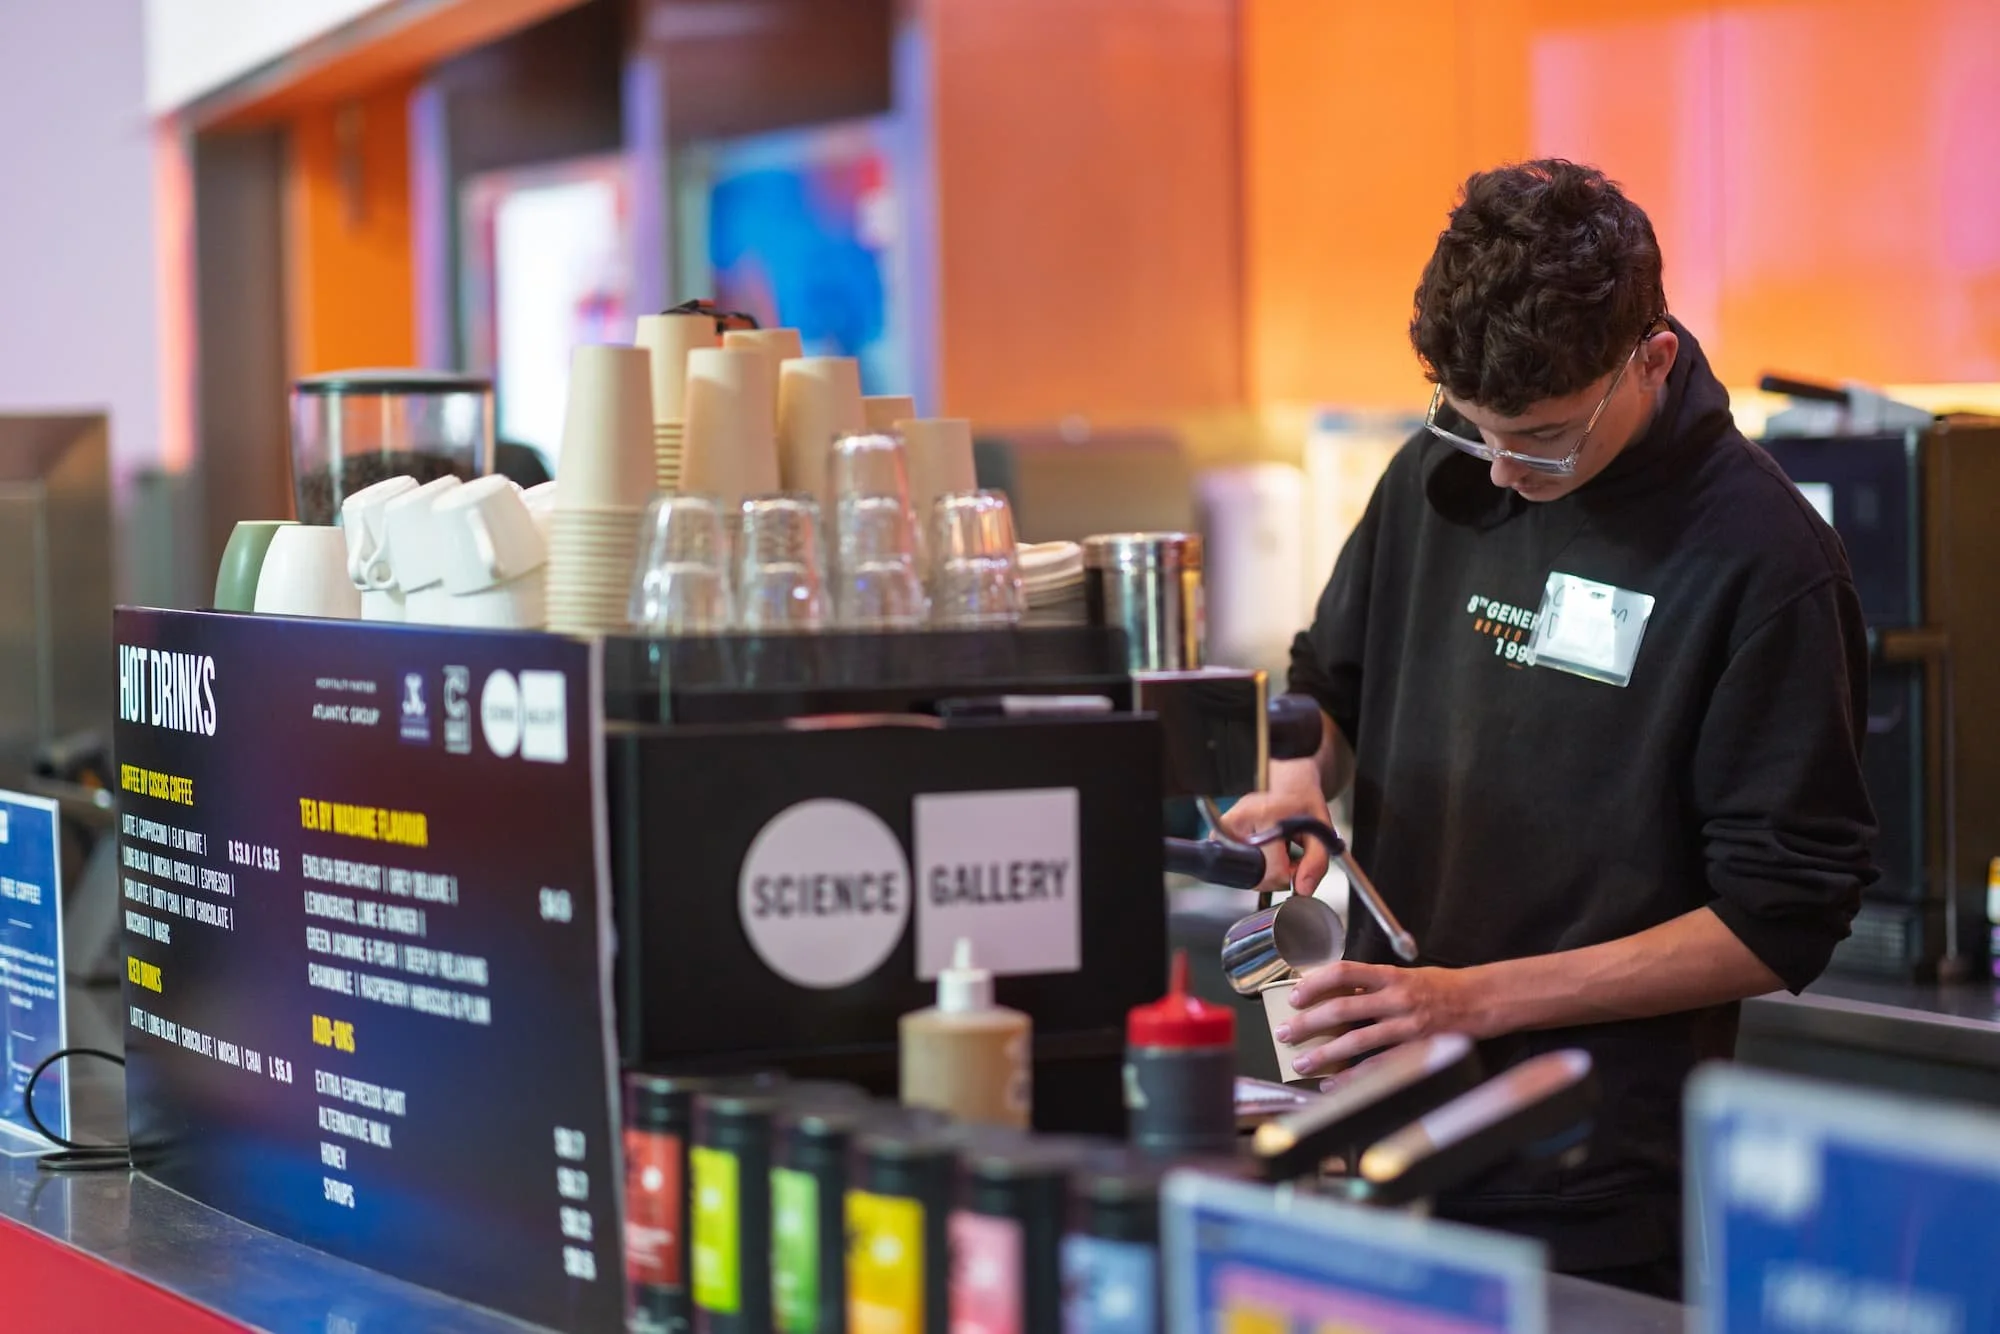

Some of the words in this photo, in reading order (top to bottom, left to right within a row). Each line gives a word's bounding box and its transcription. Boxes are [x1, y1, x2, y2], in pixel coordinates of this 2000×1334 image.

[119, 644, 147, 724] HOT
[150, 649, 217, 736] DRINKS
[312, 703, 348, 723] ATLANTIC
[349, 704, 381, 726] GROUP
[121, 762, 140, 794] COFFEE
[140, 768, 148, 796] BY
[169, 775, 193, 806] COFFEE
[122, 813, 136, 837] LATTE
[139, 818, 168, 845] CAPPUCCINO
[172, 827, 185, 849] FLAT
[185, 830, 203, 855] WHITE
[299, 797, 319, 830] TEA
[319, 800, 332, 832] BY
[333, 803, 378, 841] MADAME
[377, 807, 429, 848] FLAVOUR
[134, 849, 150, 873] BLACK
[152, 854, 171, 879] MOCHA
[173, 860, 196, 886] PICCOLO
[201, 867, 231, 895] ESPRESSO
[228, 839, 234, 862] R
[234, 840, 250, 867] $3.0
[257, 846, 263, 868] L
[263, 845, 280, 872] $3.5
[302, 853, 334, 882] ENGLISH
[334, 858, 382, 891] BREAKFAST
[388, 867, 412, 897] GREY
[412, 870, 451, 905] DELUXE
[752, 870, 899, 919] SCIENCE
[927, 857, 1068, 907] GALLERY
[124, 877, 136, 900] CHAI
[135, 881, 150, 905] LATTE
[152, 887, 167, 911] DIRTY
[167, 891, 181, 915] CHAI
[184, 897, 197, 920] HOT
[196, 900, 230, 929] CHOCOLATE
[356, 899, 377, 928] LIME
[386, 904, 419, 936] GINGER
[127, 955, 141, 985] ICED
[140, 960, 163, 993] DRINKS
[306, 926, 331, 955] GREEN
[331, 931, 365, 962] JASMINE
[373, 938, 397, 969] PEAR
[404, 944, 438, 977] DEEPLY
[438, 950, 489, 987] RELAXING
[360, 973, 410, 1009] RASPBERRY
[462, 992, 492, 1026] PLUM
[129, 1004, 145, 1030] LATTE
[147, 1012, 160, 1037] LONG
[160, 1018, 178, 1044] BLACK
[181, 1027, 213, 1057] CHOCOLATE
[217, 1039, 240, 1067] MOCHA
[245, 1048, 262, 1074] CHAI
[312, 1014, 355, 1053] ADD-ONS
[268, 1055, 275, 1079] L
[275, 1056, 293, 1084] $5.0
[315, 1068, 342, 1098] EXTRA
[341, 1075, 383, 1111] ESPRESSO
[382, 1086, 406, 1117] SHOT
[318, 1104, 370, 1143] ALTERNATIVE
[369, 1119, 392, 1149] MILK
[320, 1140, 347, 1171] HONEY
[323, 1175, 355, 1209] SYRUPS
